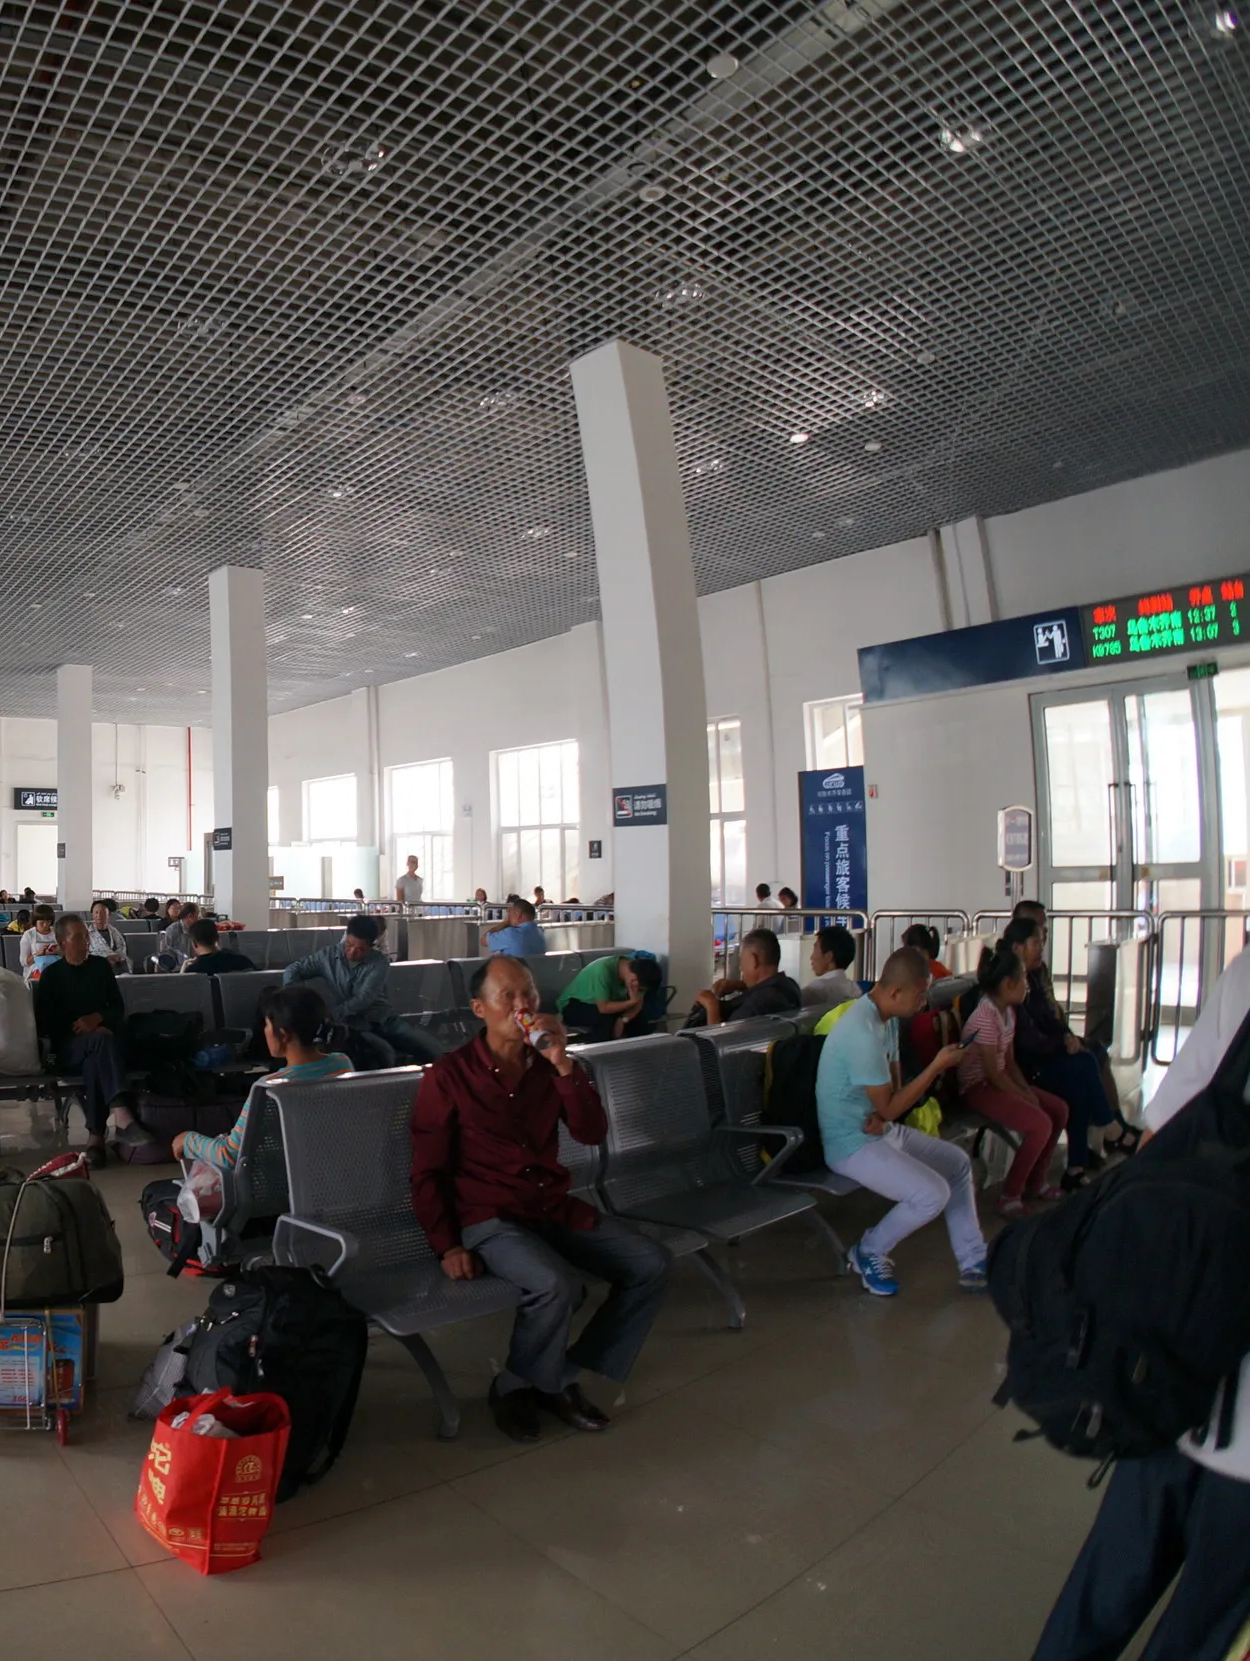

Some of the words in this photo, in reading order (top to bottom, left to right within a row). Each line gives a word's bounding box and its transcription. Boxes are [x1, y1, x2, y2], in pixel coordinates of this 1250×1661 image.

[1092, 623, 1116, 640] T307
[634, 799, 661, 810] 请勿吸烟
